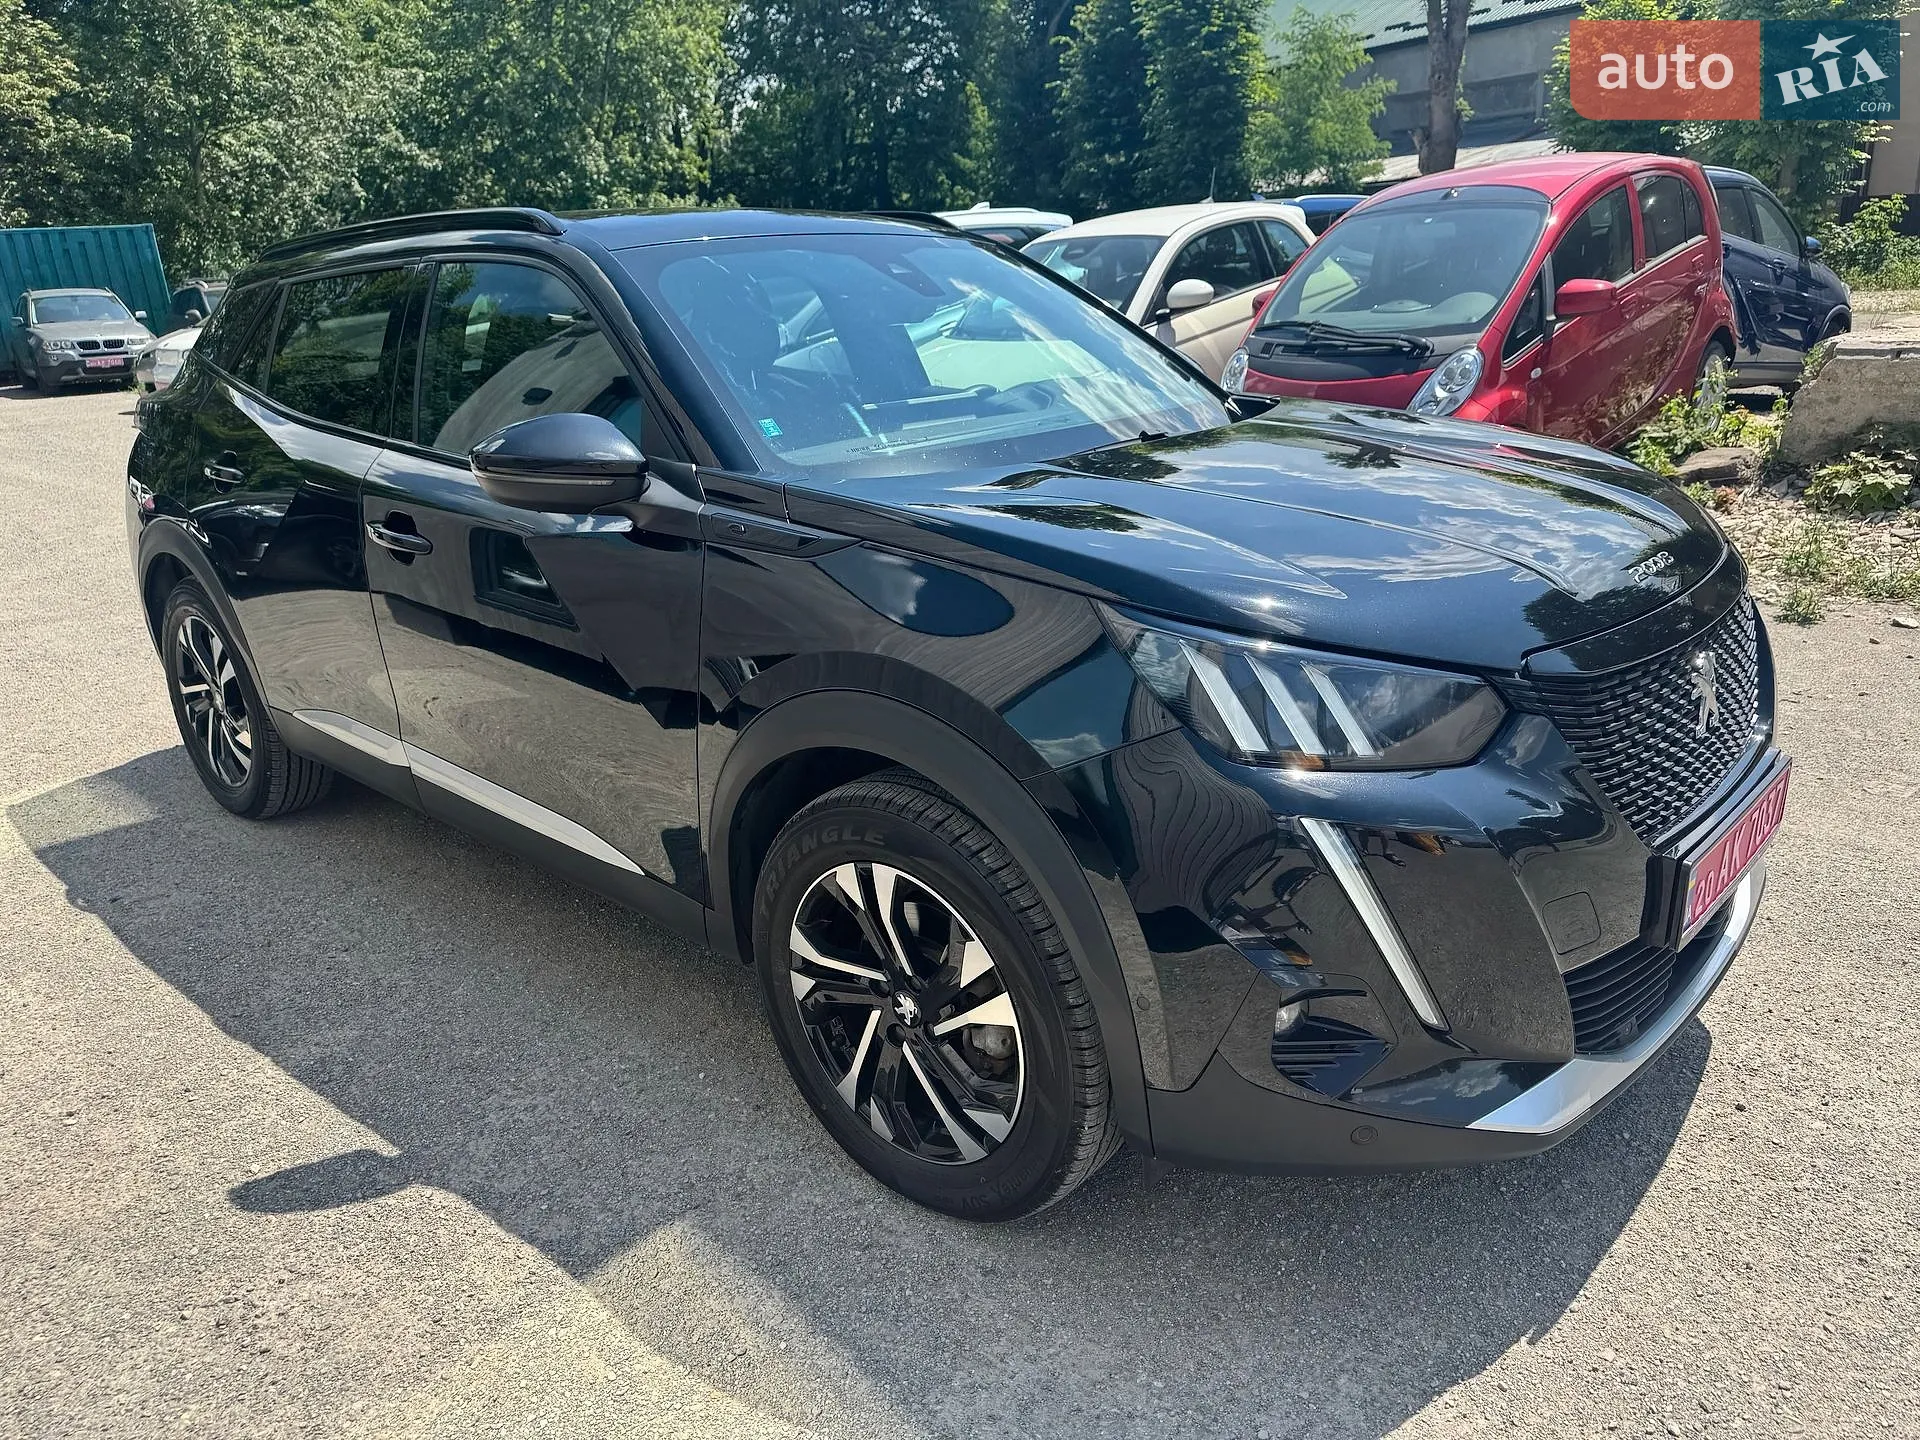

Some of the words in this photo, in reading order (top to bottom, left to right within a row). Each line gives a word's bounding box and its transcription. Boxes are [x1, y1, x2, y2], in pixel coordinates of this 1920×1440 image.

[1628, 551, 1675, 583] 2008
[759, 824, 886, 918] TRIANGLE
[1694, 870, 1715, 918] 20
[1716, 823, 1746, 893] AK
[1746, 778, 1785, 858] 7037
[960, 1194, 991, 1210] SUV
